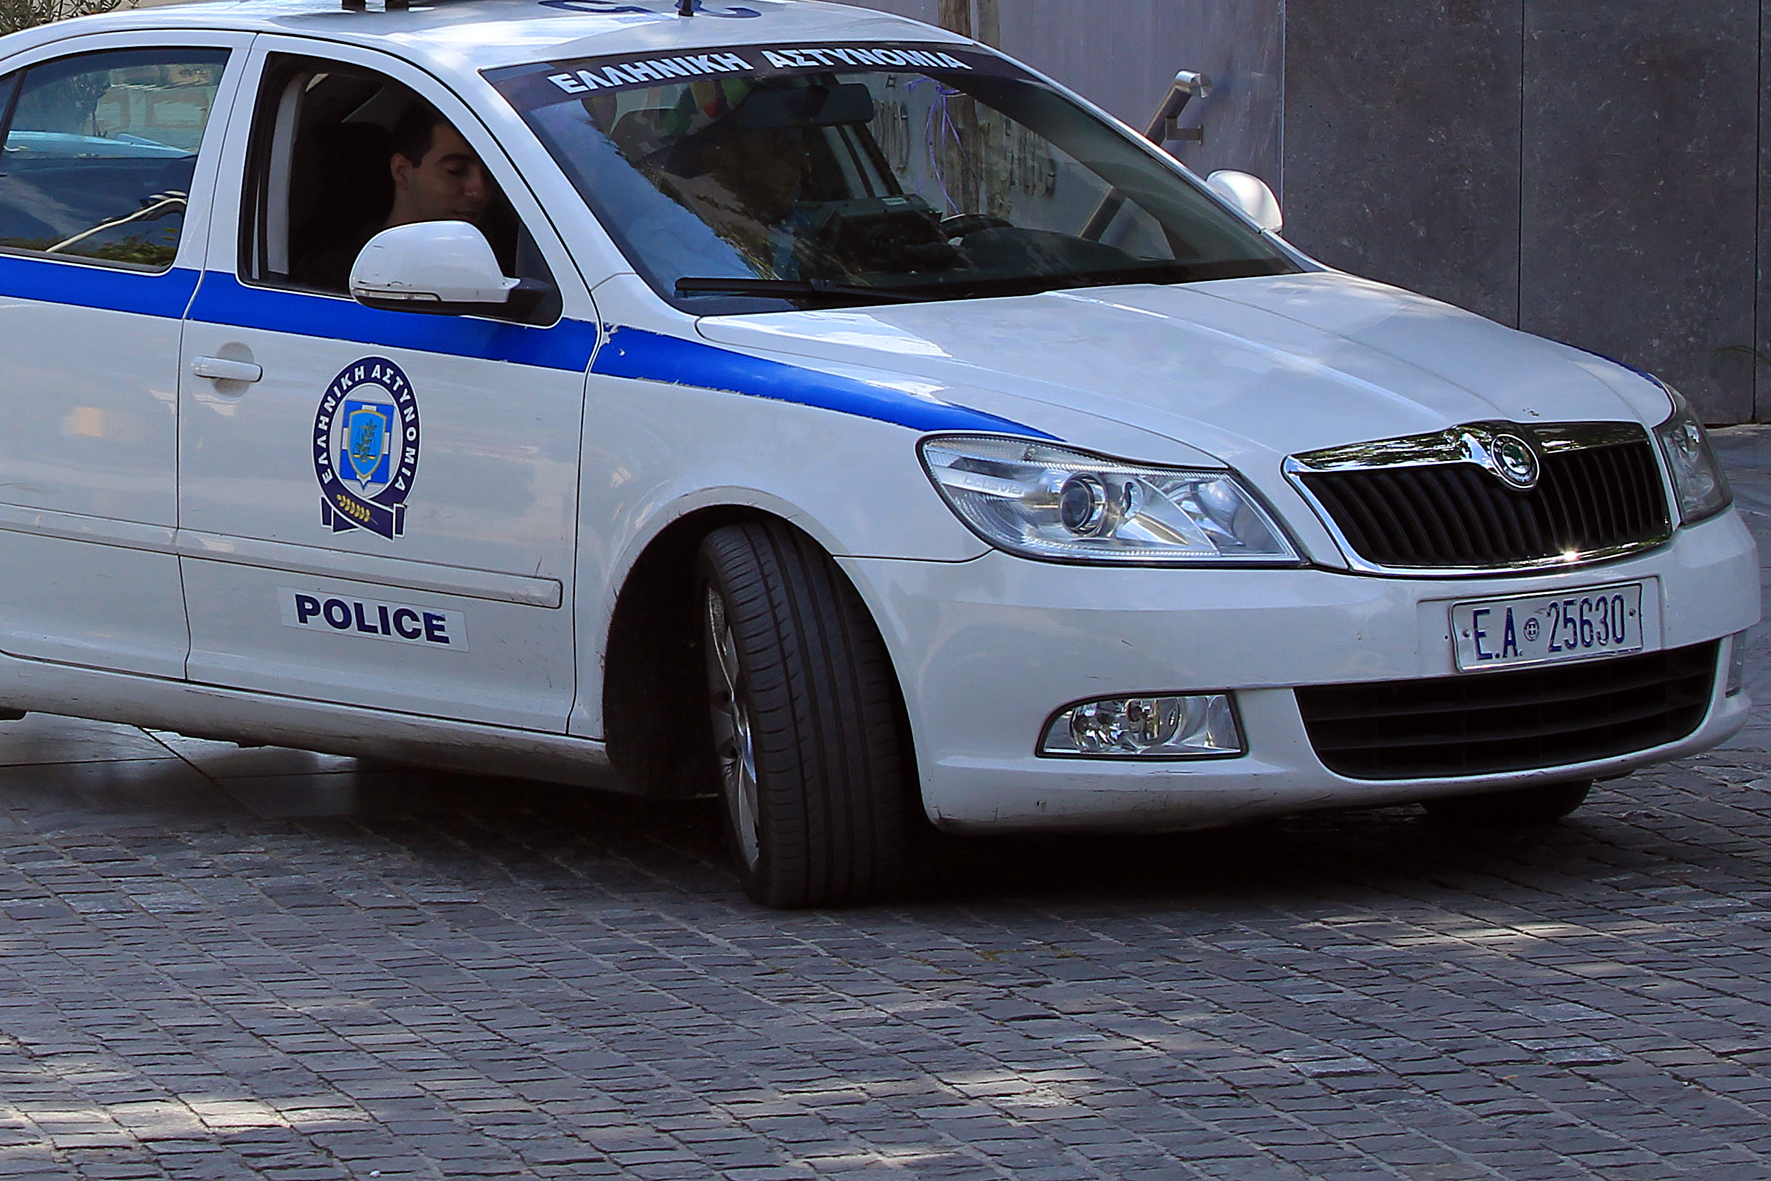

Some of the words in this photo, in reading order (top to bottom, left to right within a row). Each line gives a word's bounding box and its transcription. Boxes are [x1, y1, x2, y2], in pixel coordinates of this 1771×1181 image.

[547, 52, 754, 94] ΕΛΛΗΝΙΚΗ
[761, 48, 972, 70] ΑΣΤΥΝΟΜΙΑ
[316, 364, 365, 485] ΕΛΛΗΝΙΚΗ
[370, 363, 418, 493] ΑΣΤΥΝΟΜΙΑ
[294, 593, 450, 645] POLICE
[1547, 594, 1625, 653] 25630
